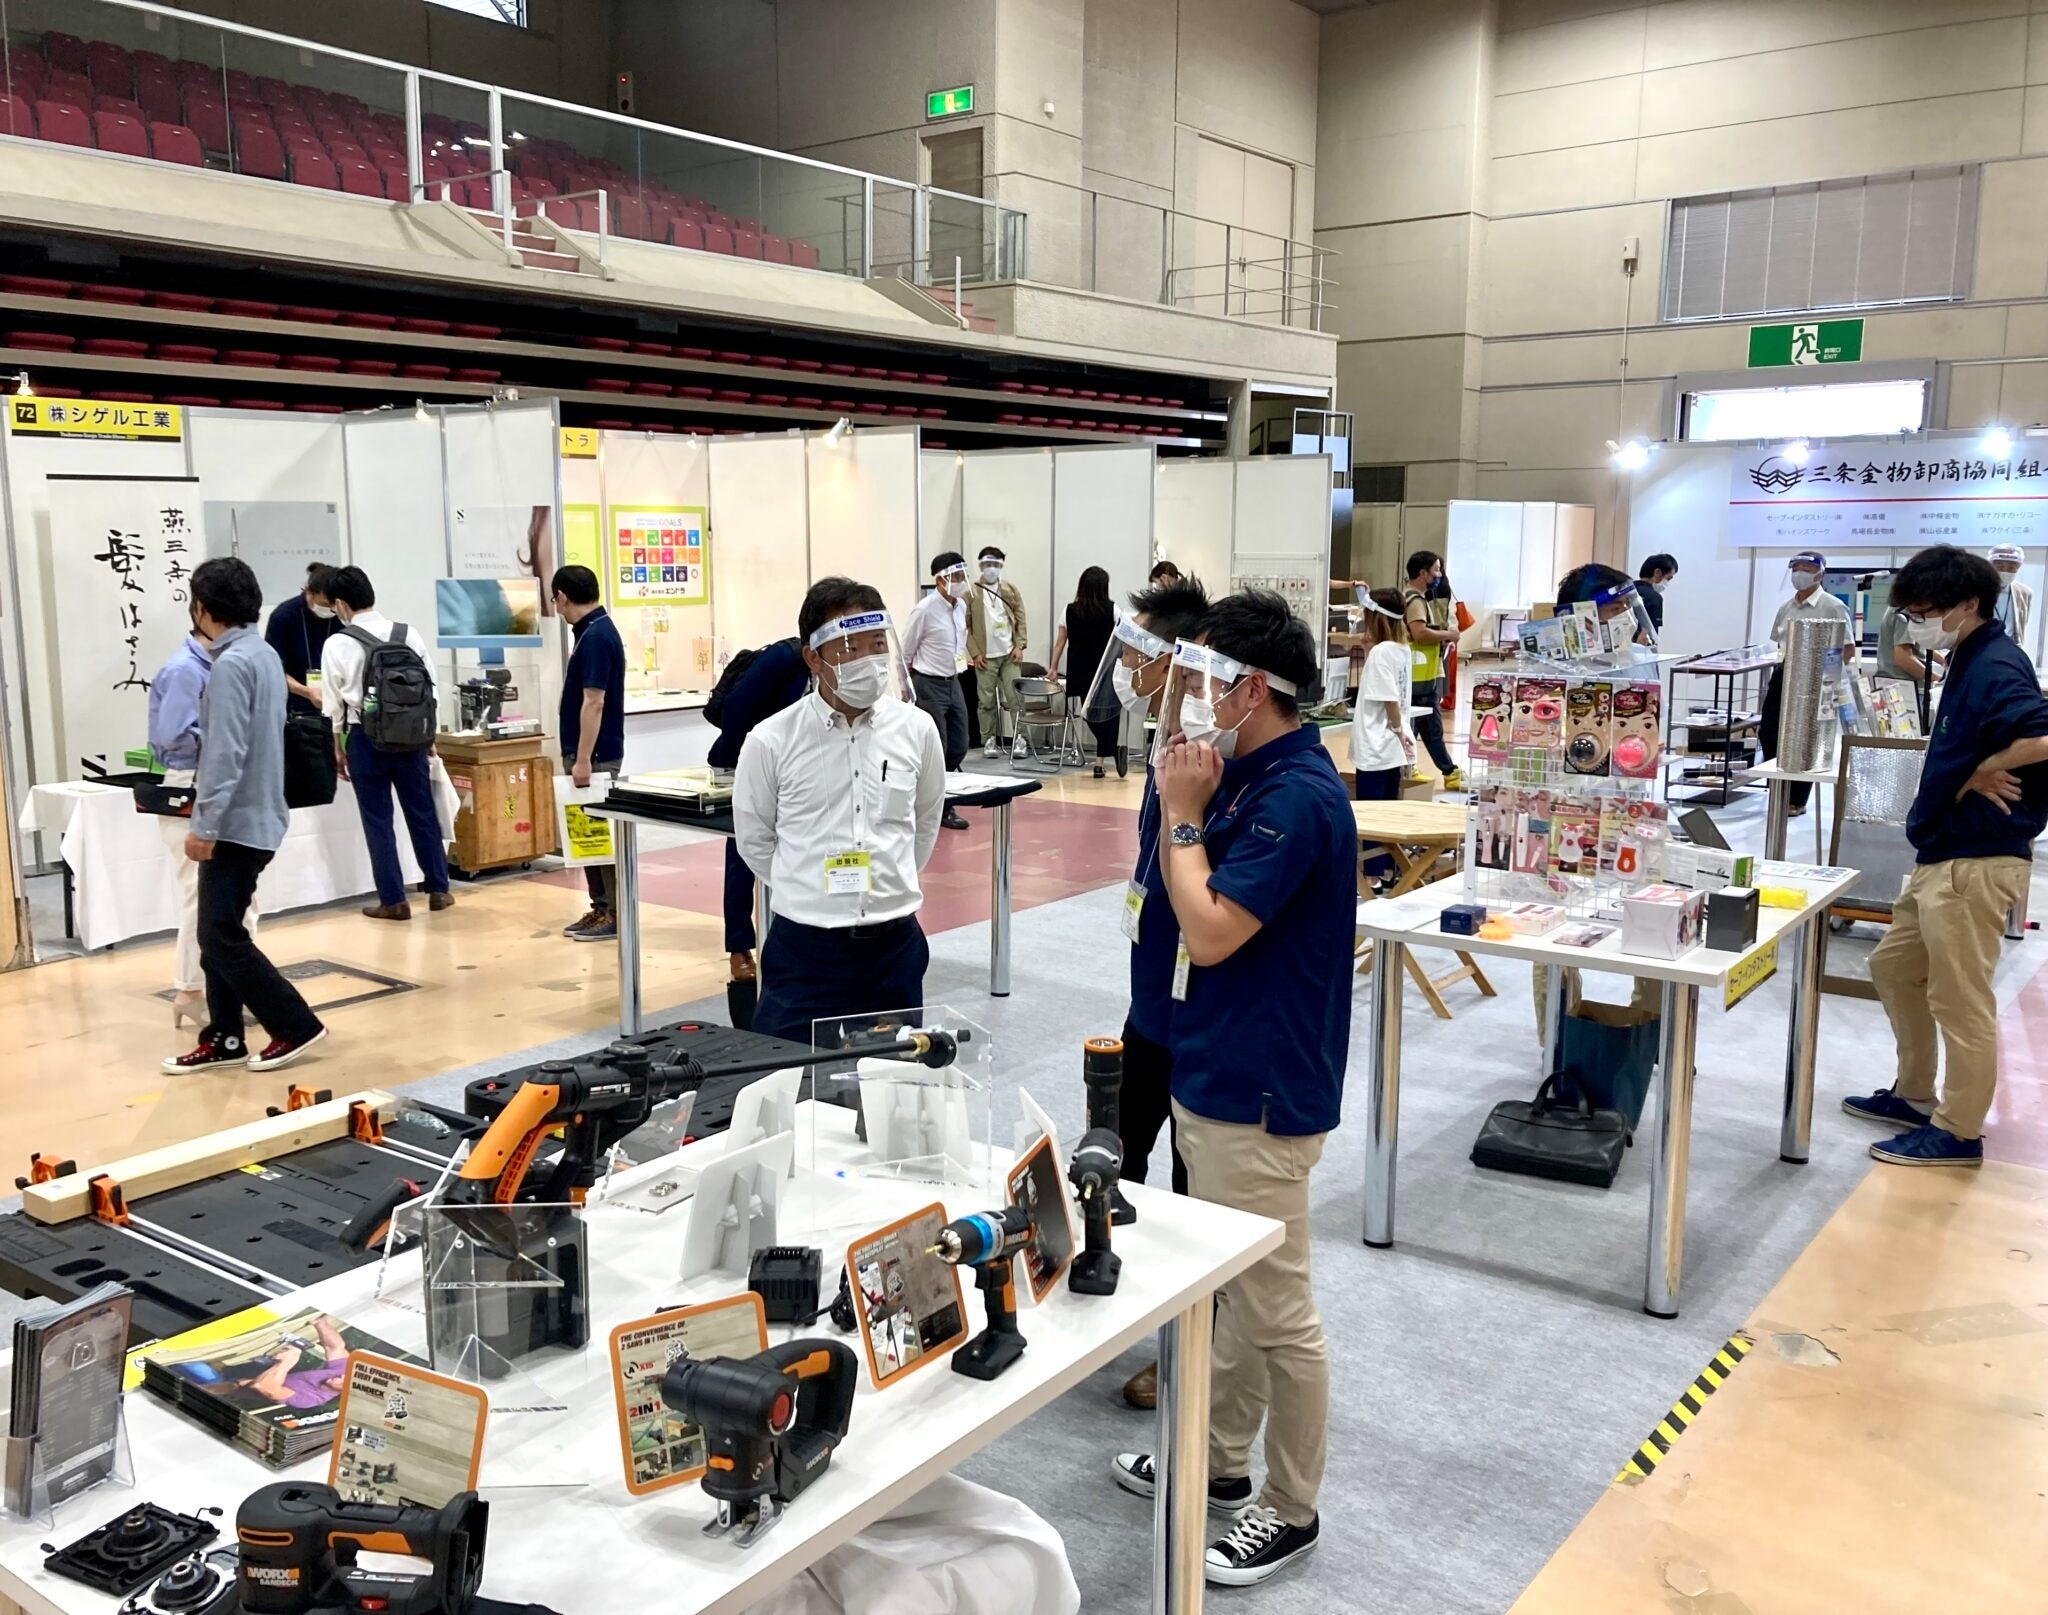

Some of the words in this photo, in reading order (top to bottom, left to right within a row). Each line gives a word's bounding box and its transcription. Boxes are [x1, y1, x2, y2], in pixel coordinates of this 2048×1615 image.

[17, 406, 35, 419] 72
[1808, 458, 2048, 485] 三条金物卸商協同組
[620, 1334, 632, 1342] THE
[634, 1324, 675, 1339] CONVENIENCE
[677, 1320, 686, 1329] OF
[621, 1343, 626, 1351] 2
[626, 1340, 643, 1350] SAWS
[644, 1337, 651, 1345] IN
[656, 1333, 670, 1342] TOOL
[355, 1363, 368, 1373] FULL
[354, 1371, 371, 1381] EVERY
[352, 1382, 384, 1398] SANDECK
[248, 1567, 299, 1580] WORX
